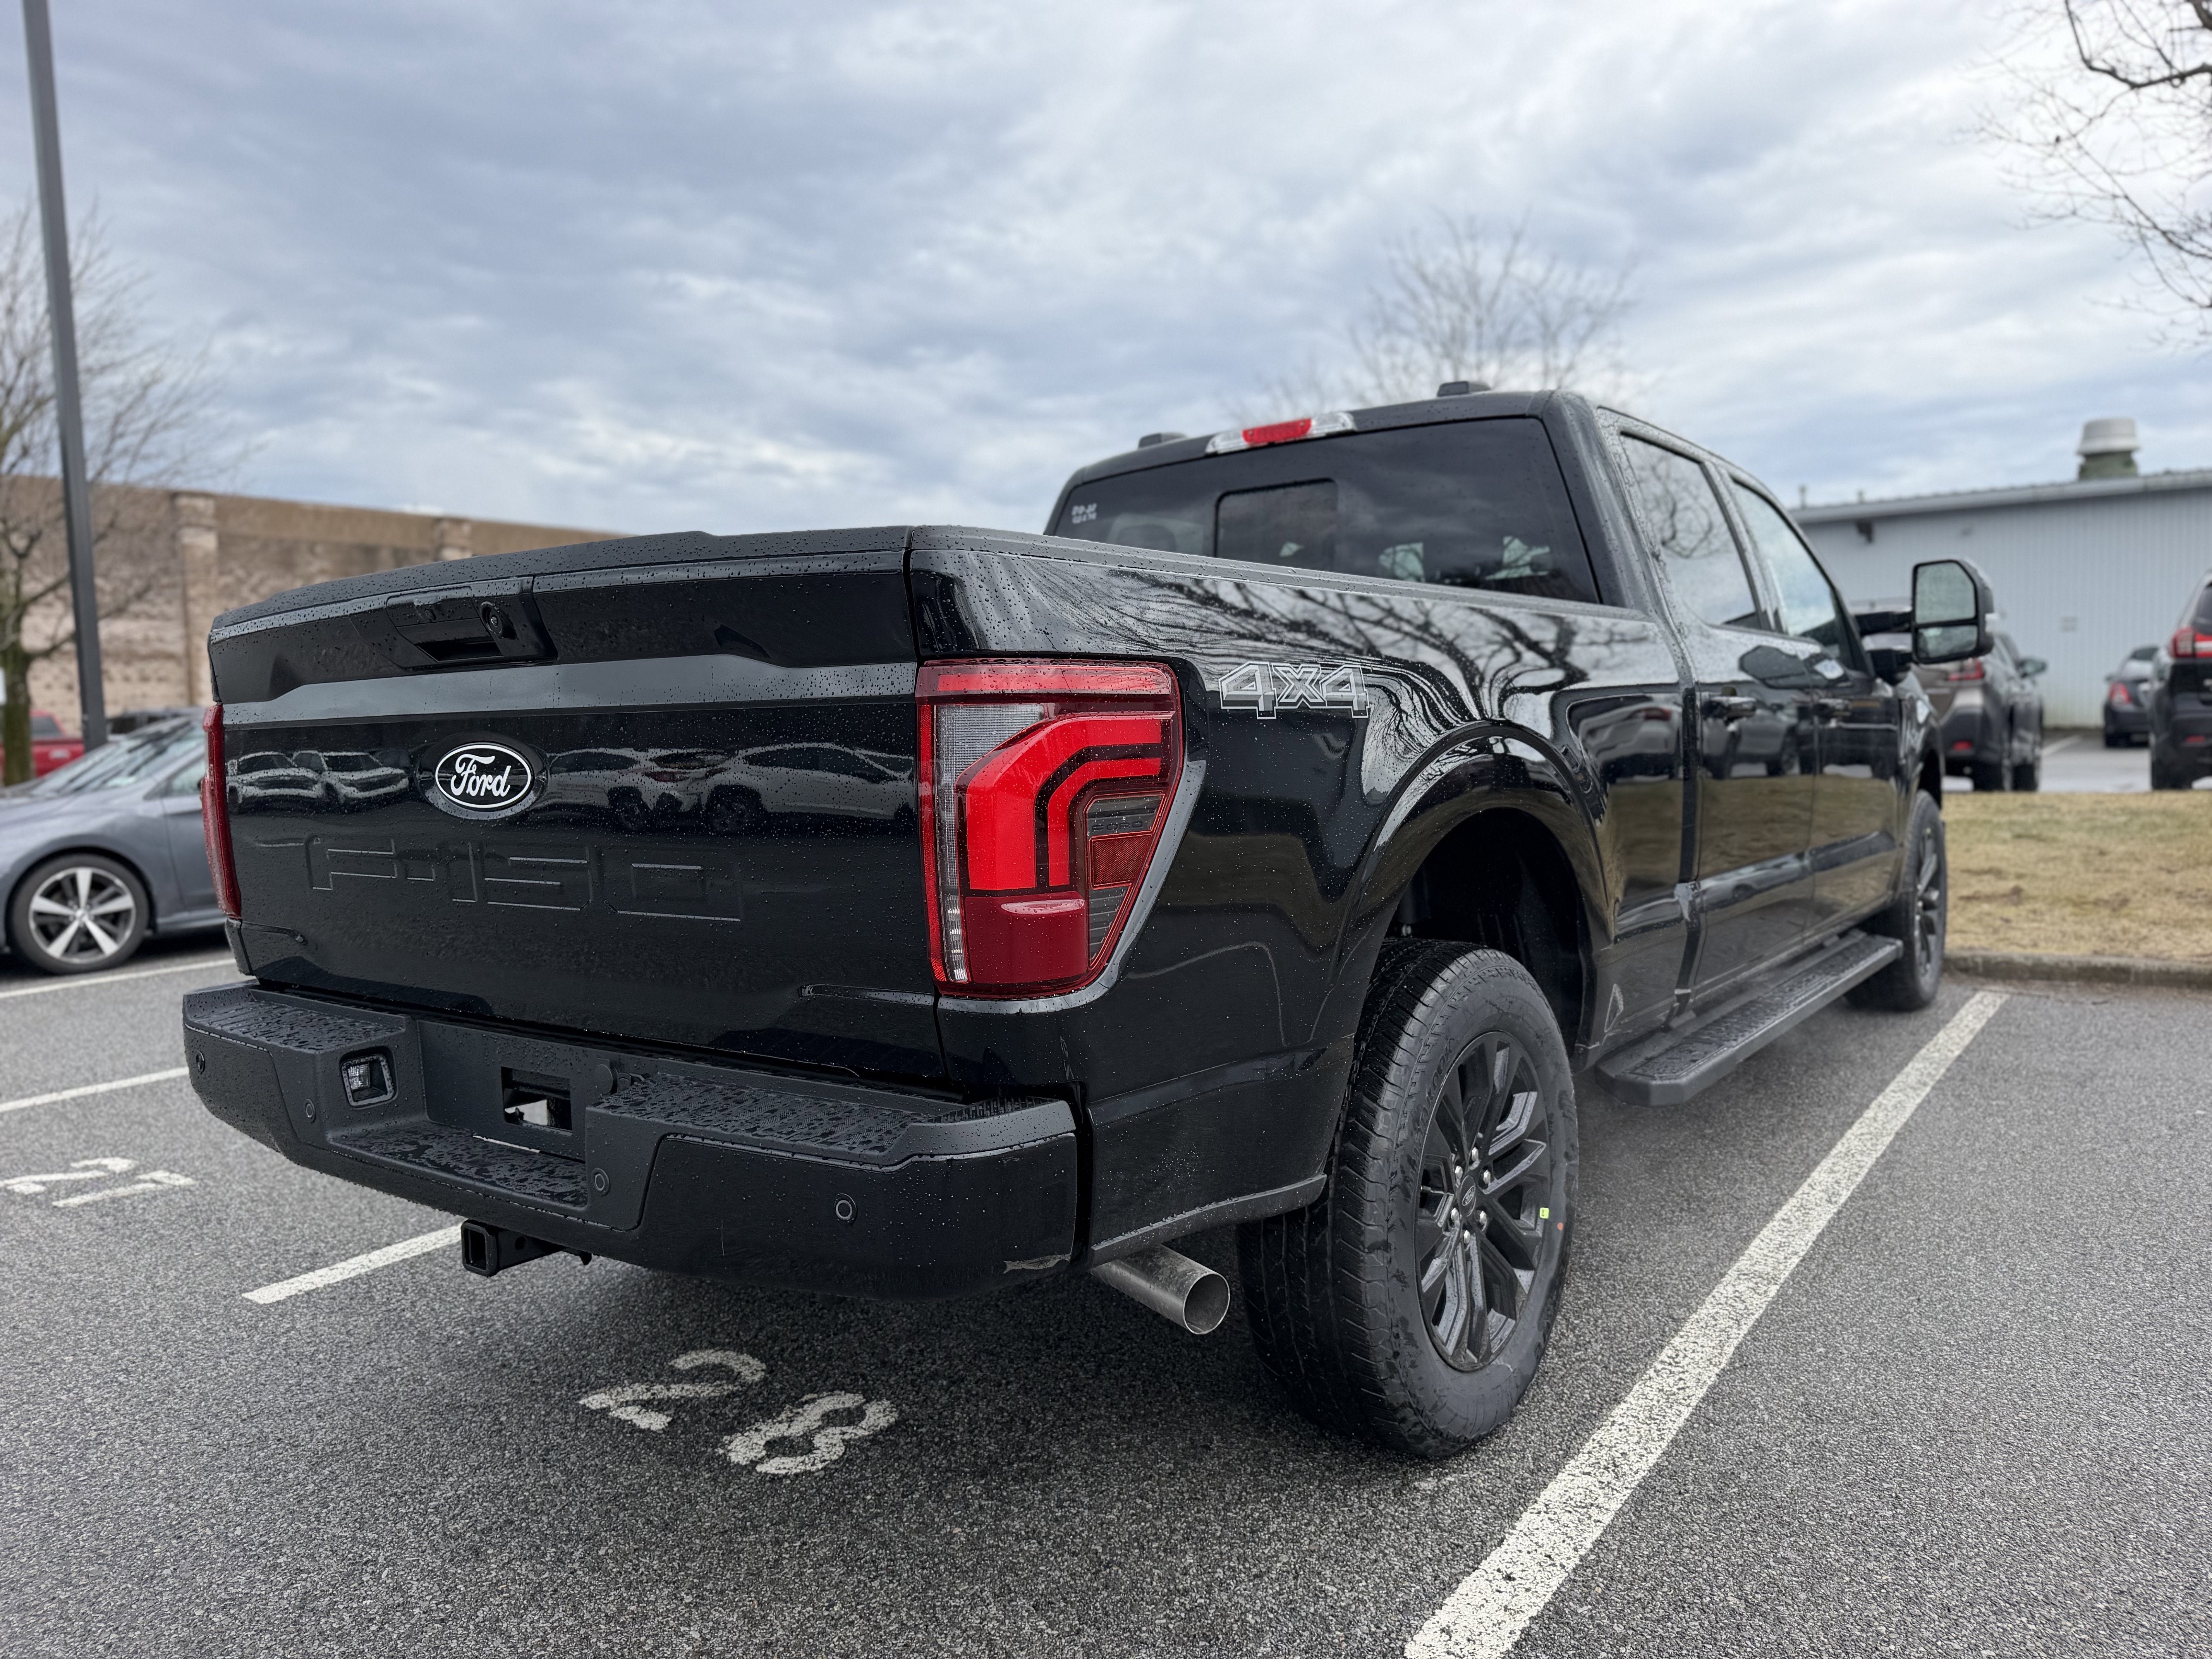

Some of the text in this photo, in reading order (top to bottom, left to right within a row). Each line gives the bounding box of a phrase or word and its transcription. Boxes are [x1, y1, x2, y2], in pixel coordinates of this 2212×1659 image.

[450, 754, 512, 797] Ford
[1091, 821, 1143, 832] FORD
[579, 1349, 899, 1474] 28
